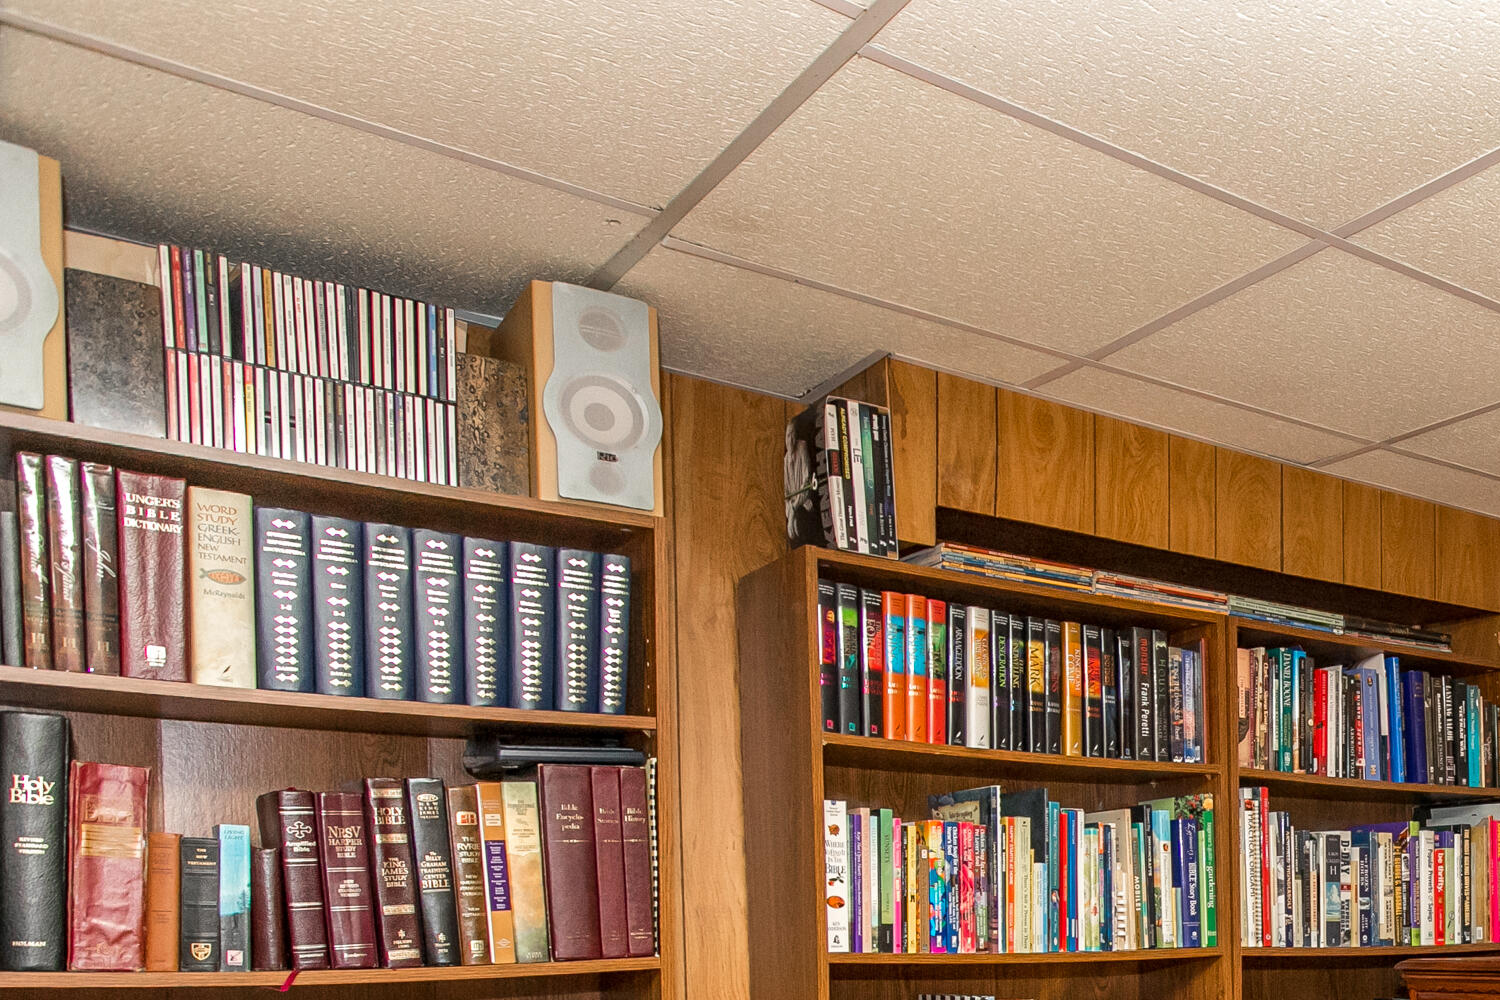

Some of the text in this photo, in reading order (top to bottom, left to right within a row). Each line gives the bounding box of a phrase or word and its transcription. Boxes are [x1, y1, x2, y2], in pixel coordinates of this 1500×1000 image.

[125, 493, 181, 508] UNGER'S
[197, 503, 237, 515] WORD
[123, 518, 183, 534] DICTIONARY
[197, 514, 238, 525] STUDY
[198, 524, 240, 535] GREEK-
[198, 534, 241, 546] ENGLISH
[198, 543, 219, 552] NEW
[199, 552, 247, 565] TESTAMENT
[998, 636, 1006, 687] DESECRATION
[1141, 638, 1149, 676] monster
[1029, 647, 1041, 686] MARK
[1283, 653, 1291, 707] DANIEL BOONE
[1140, 682, 1151, 737] Frank Peretti
[13, 774, 55, 795] Holy
[9, 788, 54, 805] Bible
[375, 807, 403, 817] HOLY
[375, 815, 405, 825] BIBLE
[328, 826, 361, 839] NRSV
[1247, 814, 1255, 859] PRACTICAL
[328, 838, 362, 846] HARPER
[1341, 840, 1350, 875] D-DAY
[1437, 853, 1443, 863] be
[383, 860, 406, 869] KING
[382, 867, 408, 876] JAMES
[422, 880, 450, 888] BIBLE
[1206, 866, 1215, 909] gardening
